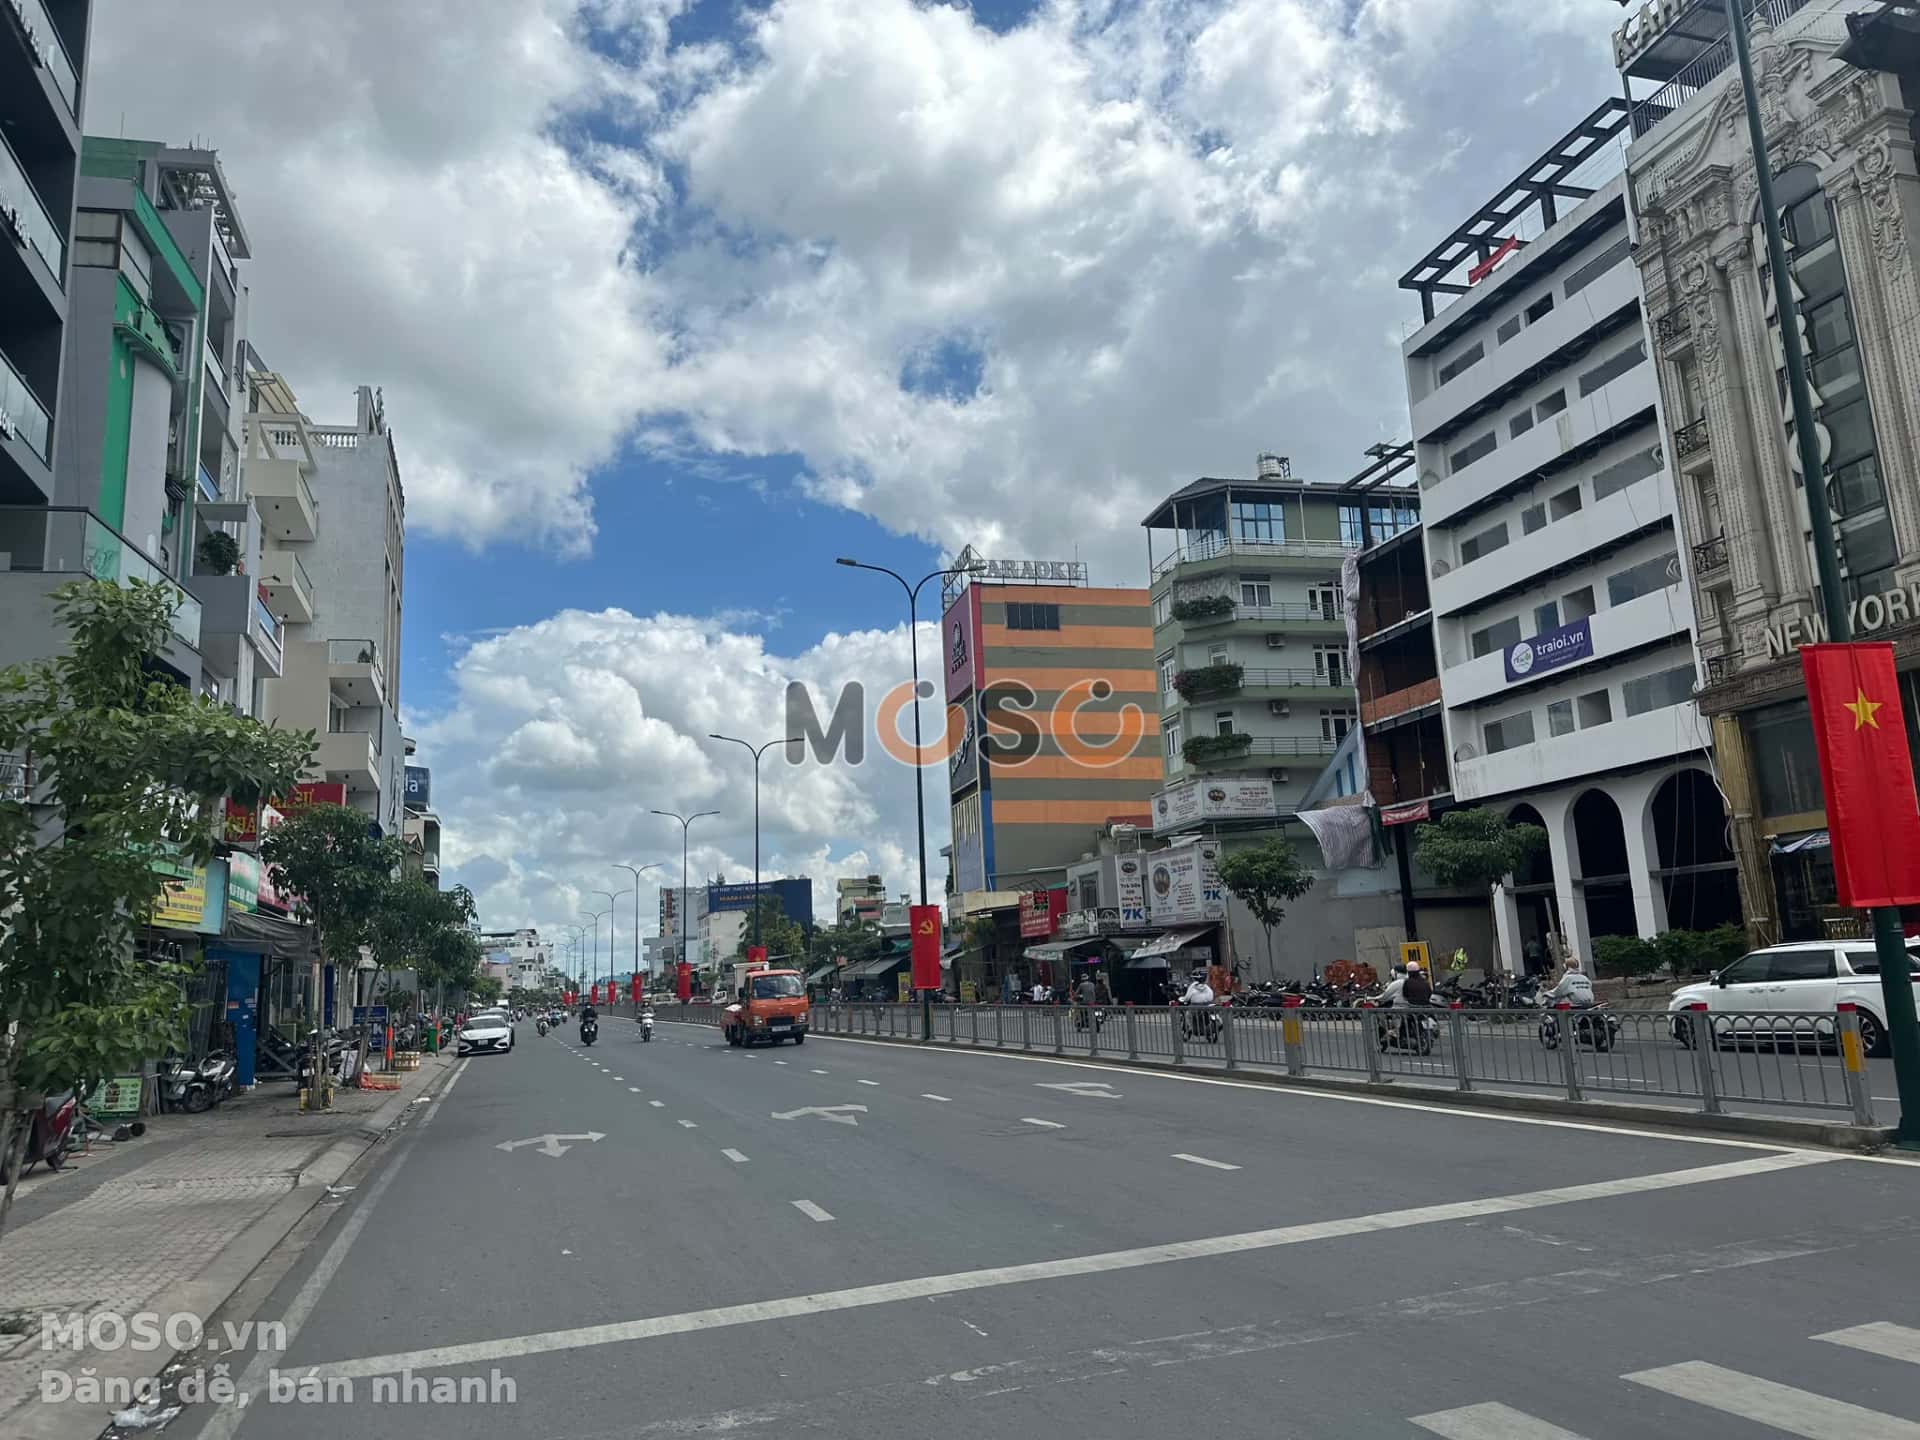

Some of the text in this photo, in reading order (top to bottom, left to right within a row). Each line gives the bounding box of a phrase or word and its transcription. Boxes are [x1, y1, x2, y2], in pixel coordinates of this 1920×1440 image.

[968, 559, 1083, 580] KARAOKE
[1536, 631, 1584, 656] traioi.vn
[1763, 612, 1829, 658] NEW
[1204, 889, 1222, 901] 7K
[1122, 908, 1145, 921] 7K
